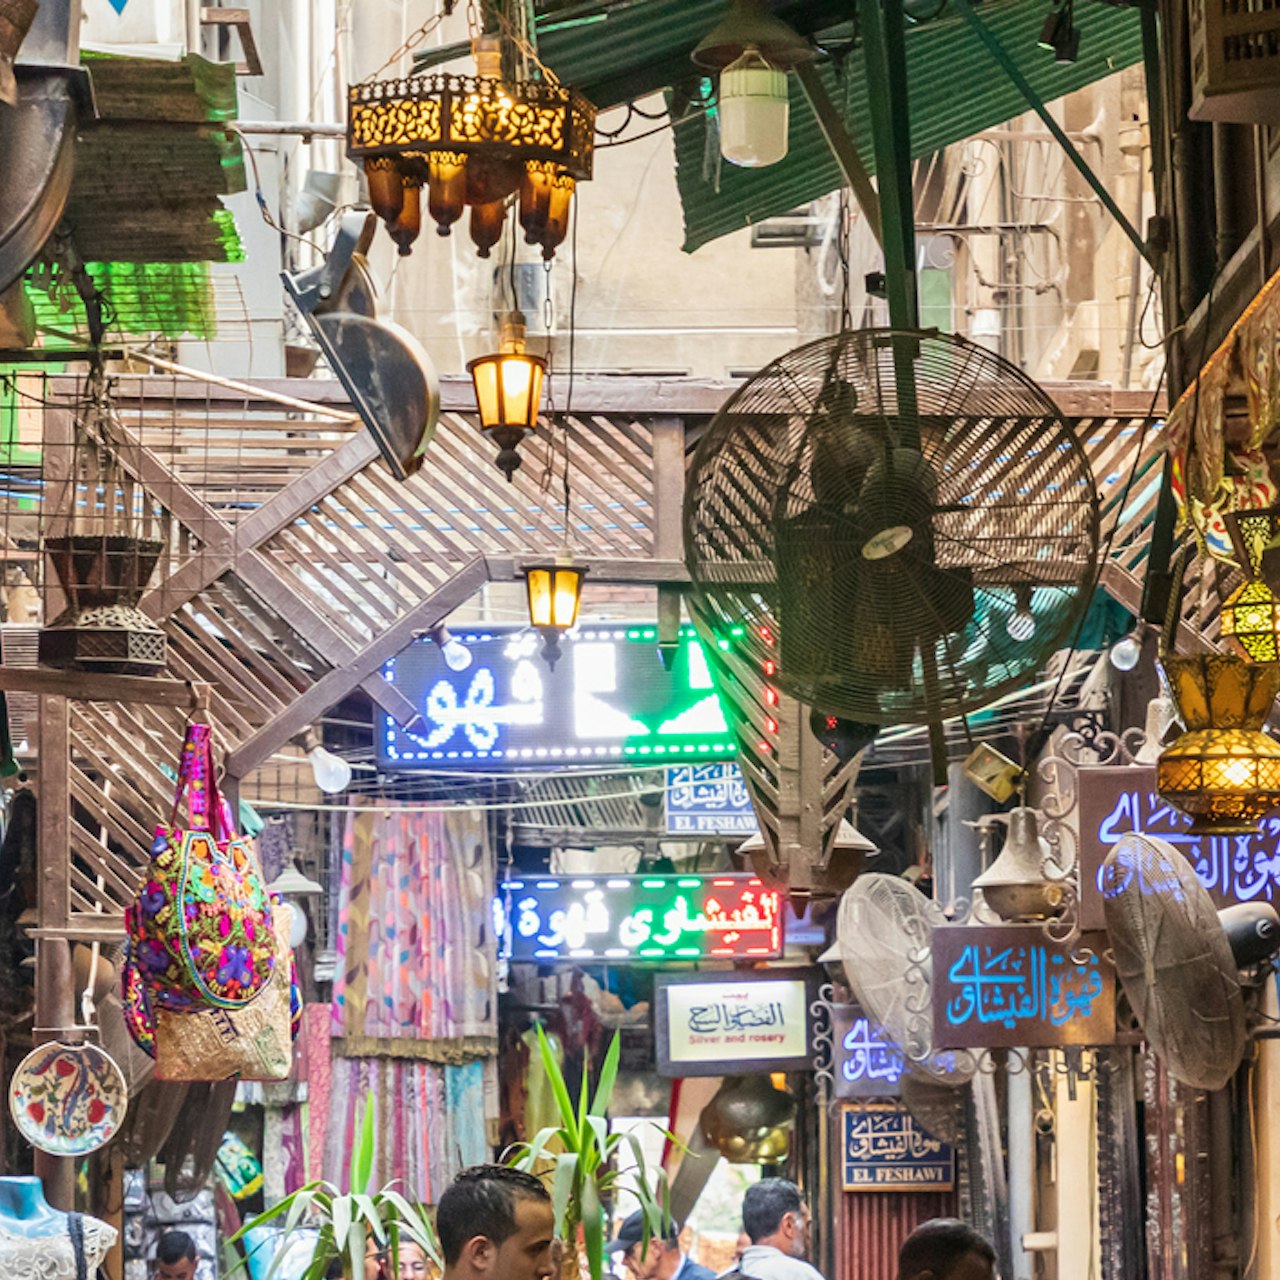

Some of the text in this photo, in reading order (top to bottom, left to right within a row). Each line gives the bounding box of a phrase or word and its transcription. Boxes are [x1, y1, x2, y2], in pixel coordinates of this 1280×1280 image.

[675, 815, 758, 831] EL FESHAW
[518, 889, 610, 948] قهوة
[1049, 952, 1104, 1027] قهوة
[688, 1035, 720, 1045] Silver
[724, 1034, 746, 1043] and
[853, 1167, 943, 1182] EL FESHAWI
